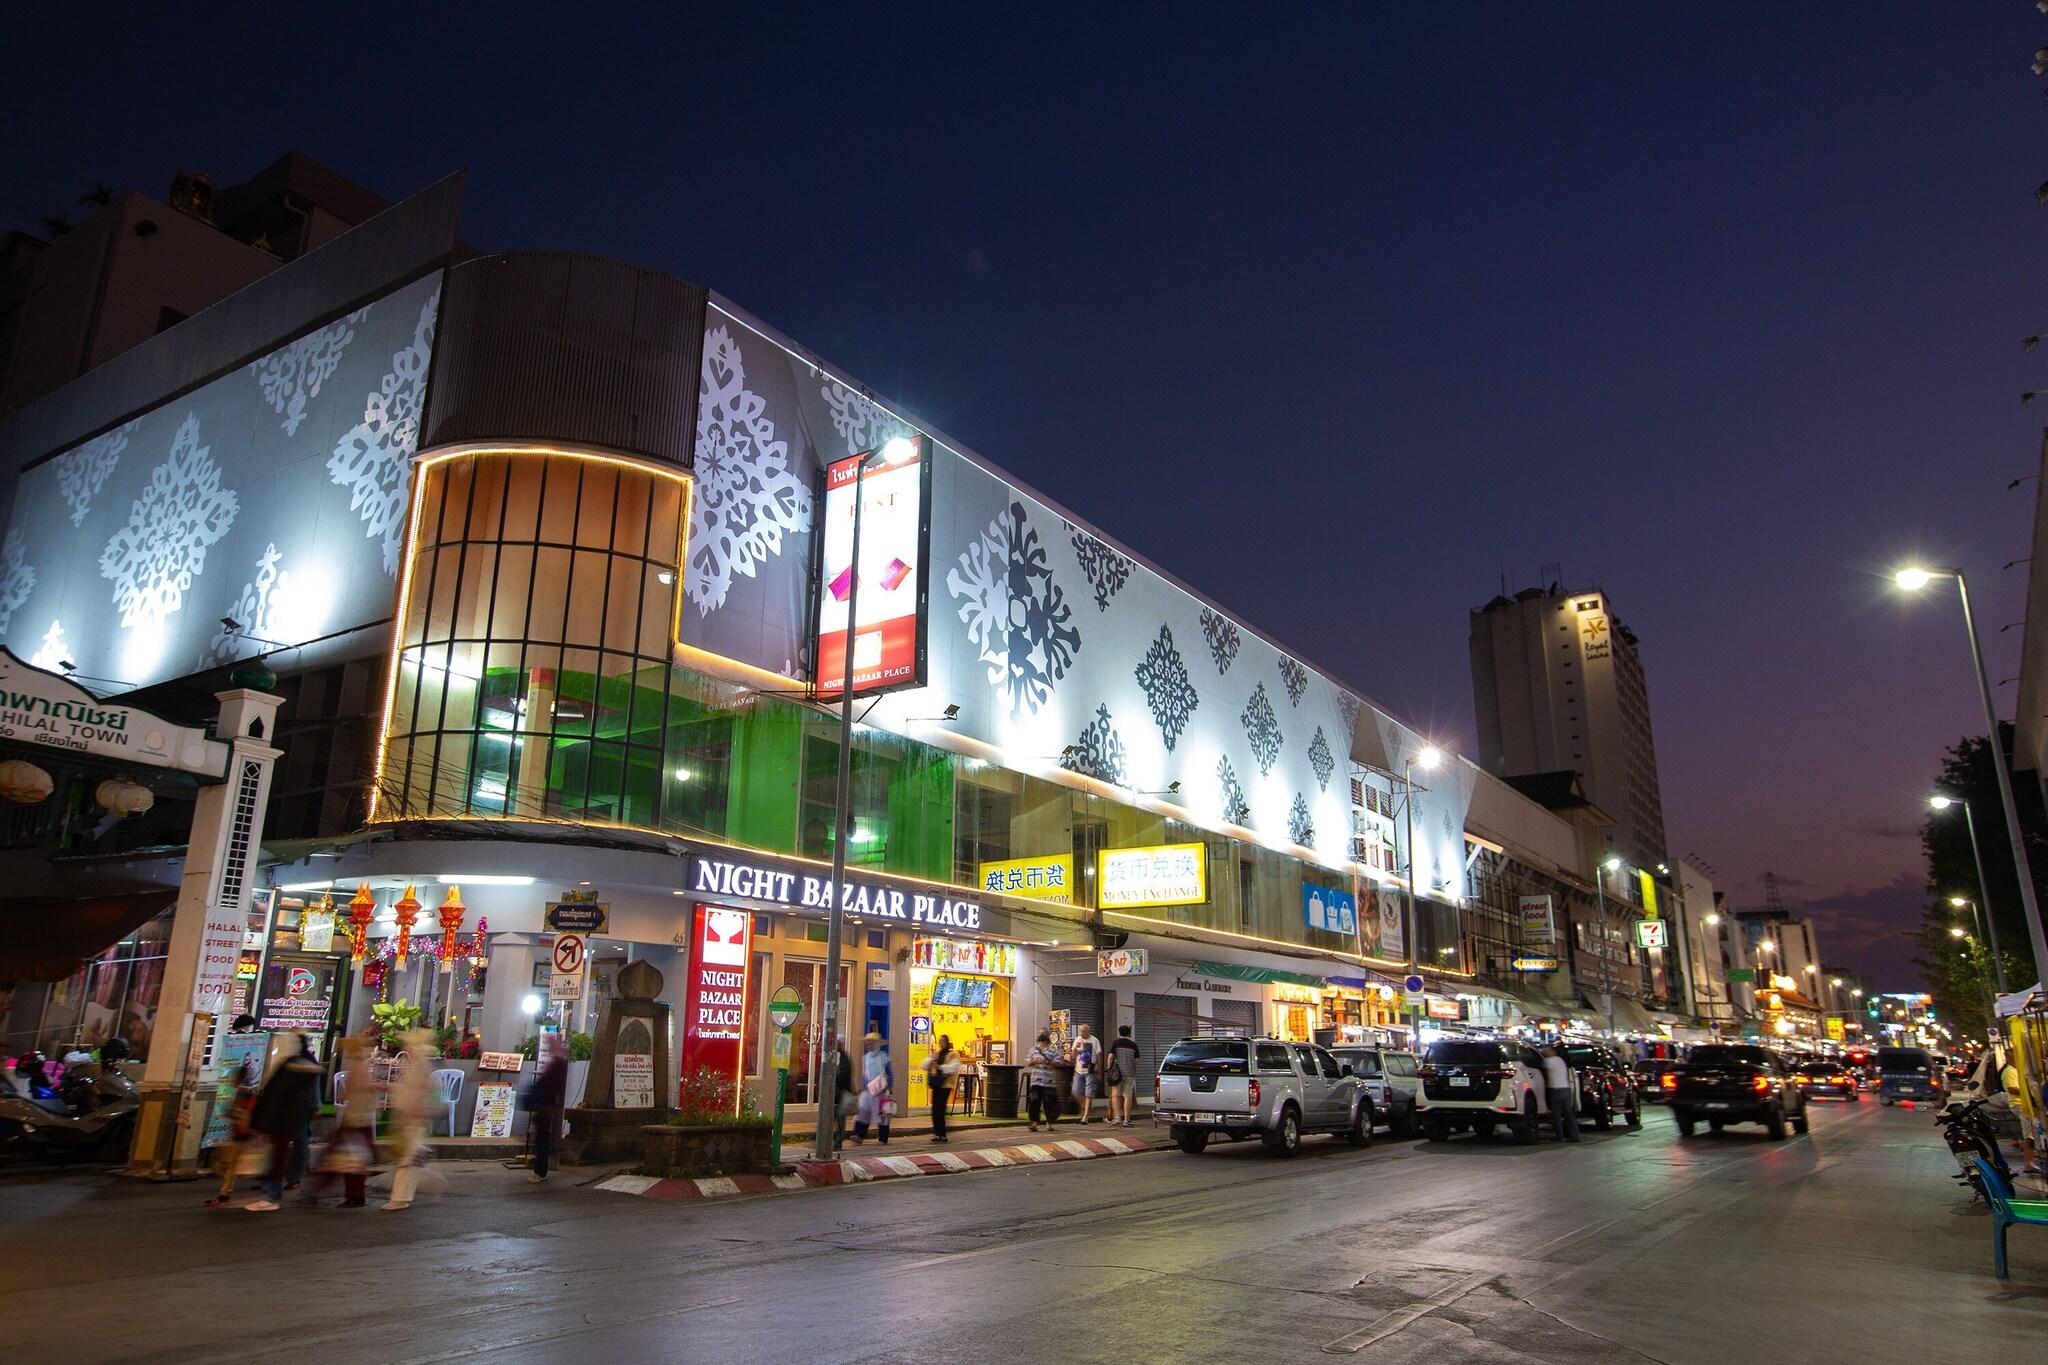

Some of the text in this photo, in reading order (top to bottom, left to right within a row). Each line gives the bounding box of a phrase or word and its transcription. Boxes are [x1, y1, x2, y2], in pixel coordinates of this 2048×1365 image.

[823, 678, 845, 689] NIGH
[884, 666, 910, 677] PLACE
[2, 710, 129, 745] HILAL TOWN
[1109, 854, 1196, 882] 货币兑换
[696, 860, 980, 928] NIGHT BAZAAR PLACE
[1524, 911, 1547, 921] food
[207, 923, 242, 933] HALAL
[206, 939, 240, 948] STREET
[205, 955, 234, 964] FOOD
[701, 970, 744, 988] NIGHT
[700, 990, 742, 1006] BAZAAR
[699, 1008, 741, 1025] PLACE
